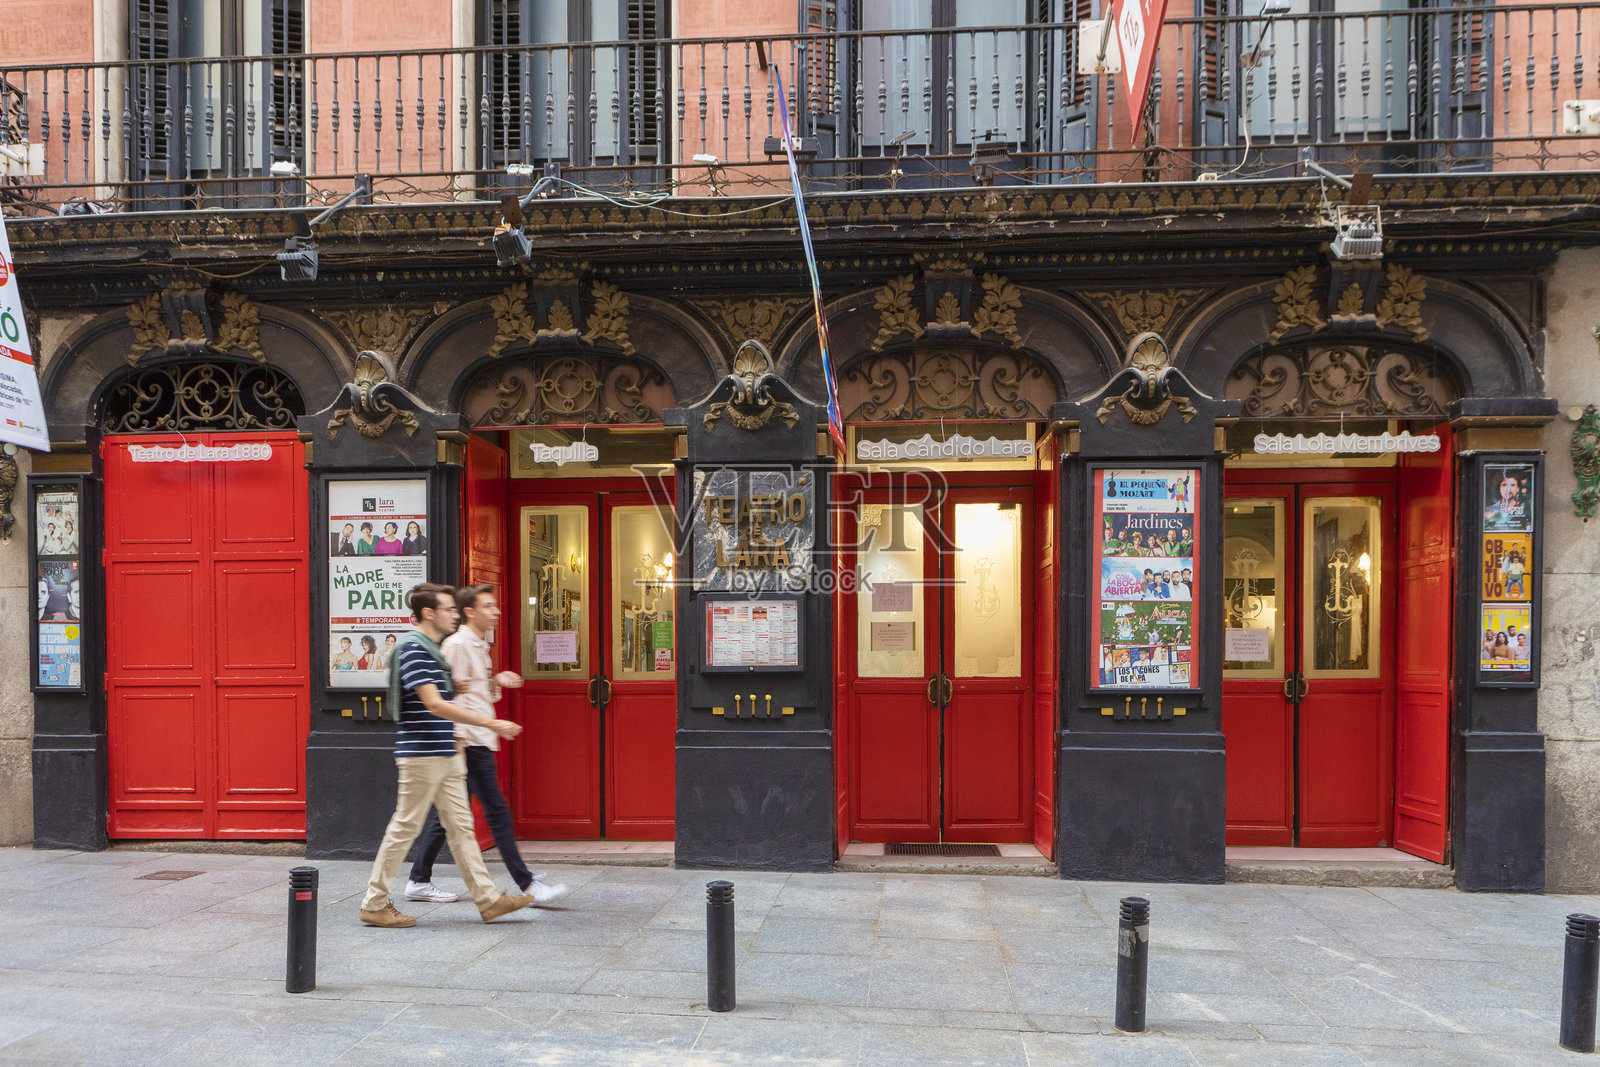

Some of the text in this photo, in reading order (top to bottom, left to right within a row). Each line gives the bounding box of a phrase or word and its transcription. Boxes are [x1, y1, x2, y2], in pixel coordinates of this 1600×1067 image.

[0, 307, 19, 343] Ó
[859, 436, 1034, 458] Sala Cándido Lara
[1255, 433, 1440, 452] Sala Lola Membrives
[132, 446, 268, 460] Teatro de Lara 1880
[532, 443, 596, 466] Taquilla
[1130, 480, 1166, 489] PEQUEÑO
[704, 494, 806, 525] TEATRO
[1125, 514, 1183, 529] Jardines
[745, 526, 762, 537] DE
[716, 538, 790, 568] LARA
[336, 565, 349, 573] LA
[334, 568, 384, 589] MADRE
[1116, 578, 1141, 587] BOCA
[1104, 586, 1140, 595] ABIERTA
[1484, 616, 1501, 632] LA
